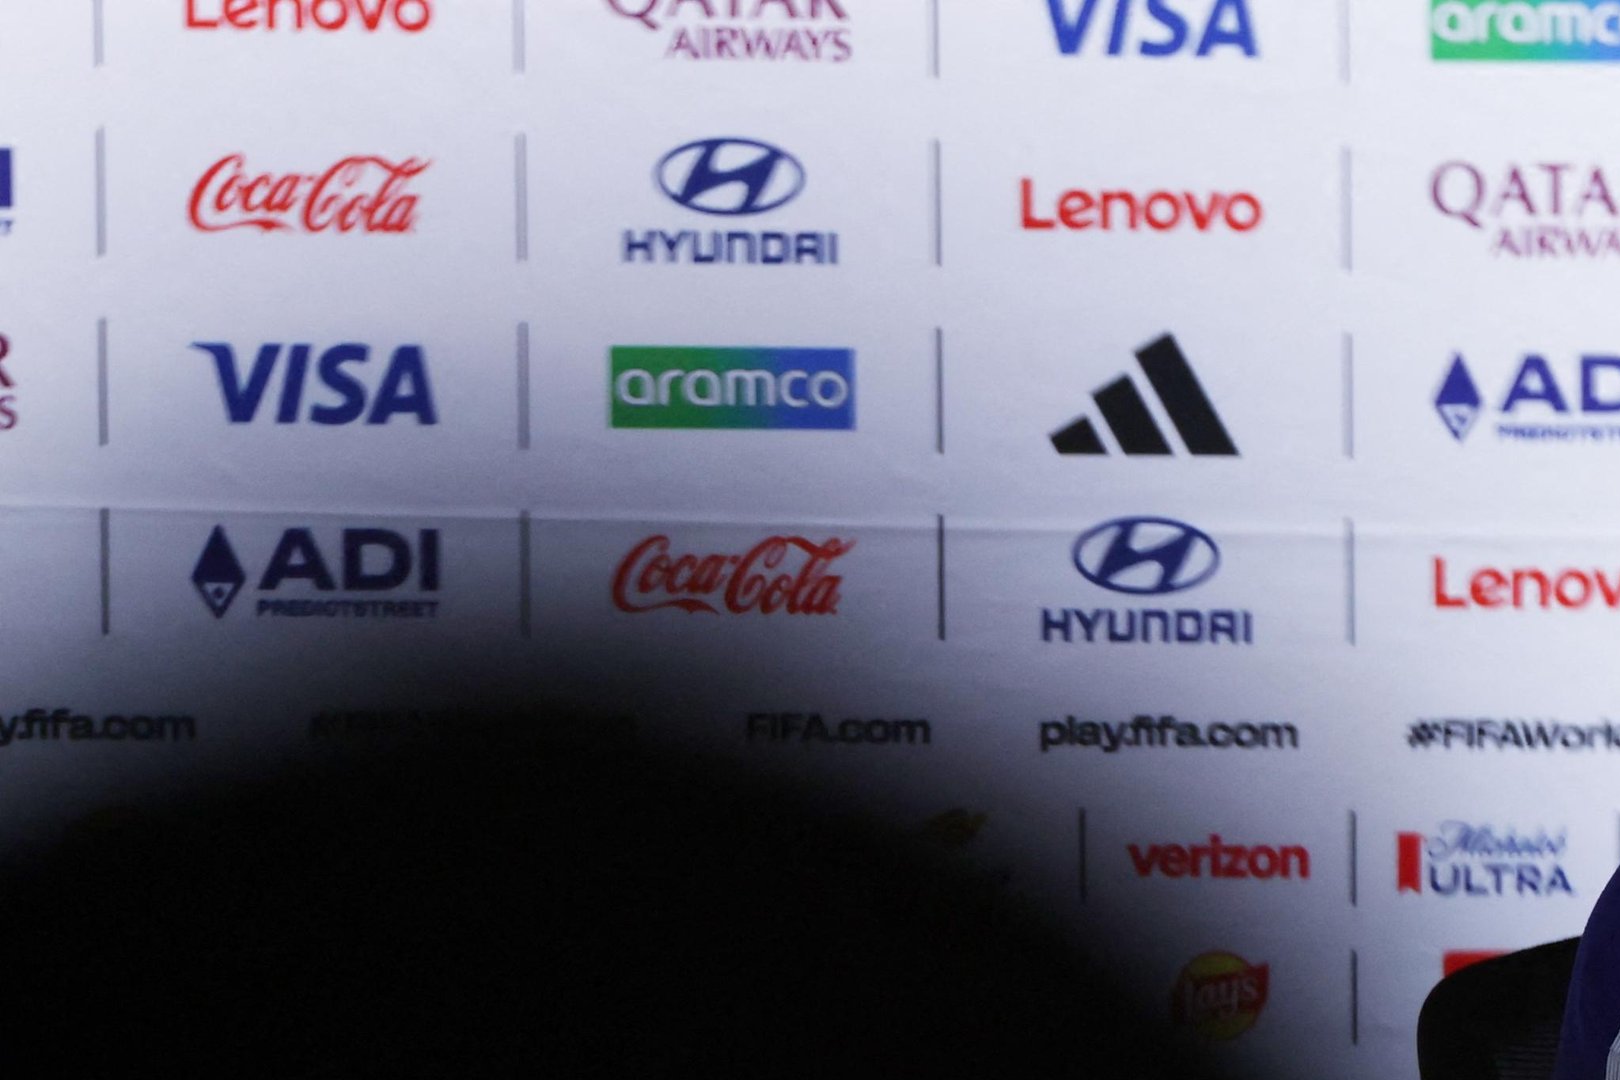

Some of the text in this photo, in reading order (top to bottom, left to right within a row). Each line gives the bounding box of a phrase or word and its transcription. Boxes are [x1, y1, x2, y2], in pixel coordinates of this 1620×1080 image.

[666, 27, 853, 62] AIRWAYS
[1046, 0, 1259, 58] VISA
[187, 154, 430, 234] Coca-Cola
[1020, 177, 1263, 233] Lenovo
[622, 230, 839, 266] HYUNDAI
[190, 342, 440, 426] VISA
[616, 367, 848, 410] aramco
[256, 527, 441, 592] ADI
[610, 533, 858, 617] Coca-Cola
[1039, 607, 1253, 645] HYUNDAI
[0, 706, 197, 748] y.fifa.com
[746, 711, 932, 745] FIFA.com
[1037, 713, 1300, 754] play.fifa.com
[1126, 832, 1312, 880] verizon
[1428, 862, 1574, 897] ULTRA
